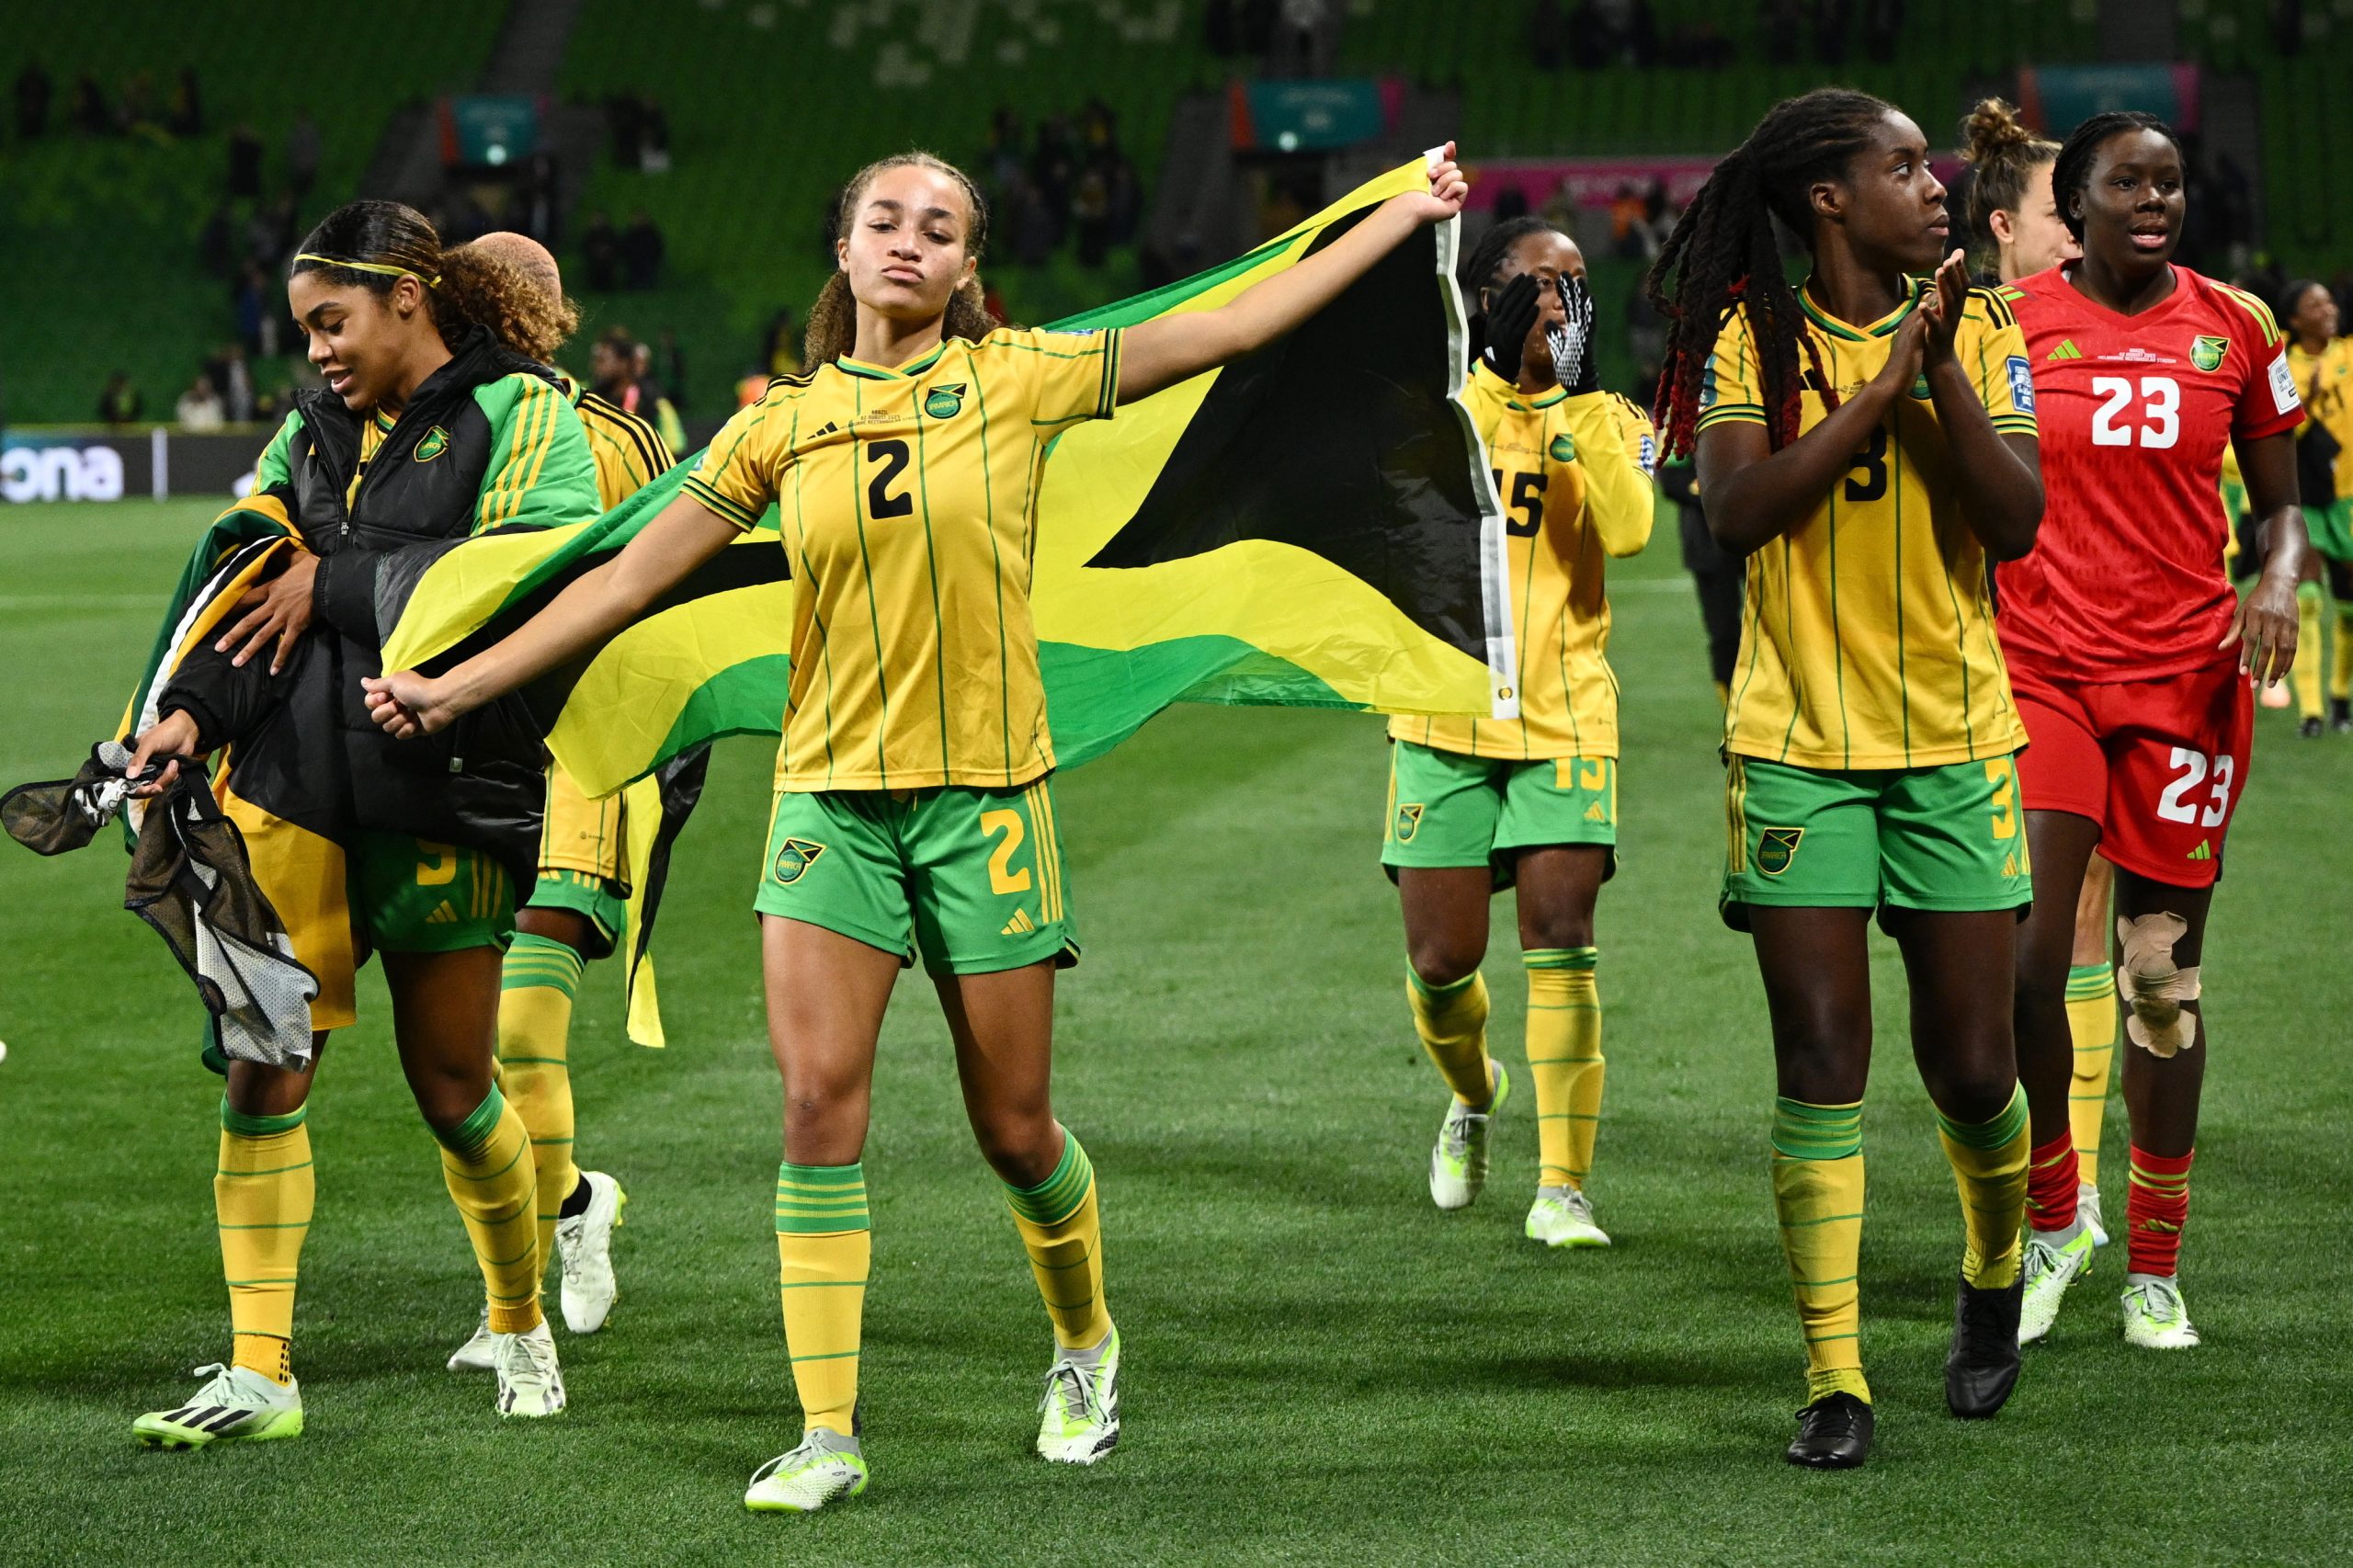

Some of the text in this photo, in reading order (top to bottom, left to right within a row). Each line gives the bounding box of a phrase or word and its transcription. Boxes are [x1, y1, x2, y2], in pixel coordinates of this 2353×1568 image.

[2092, 377, 2180, 449] 23
[868, 439, 913, 519] 2
[1845, 423, 1887, 502] 3
[1493, 469, 1549, 538] 5
[1984, 758, 2016, 839] 3
[2156, 746, 2234, 827] 23
[980, 808, 1030, 895] 2
